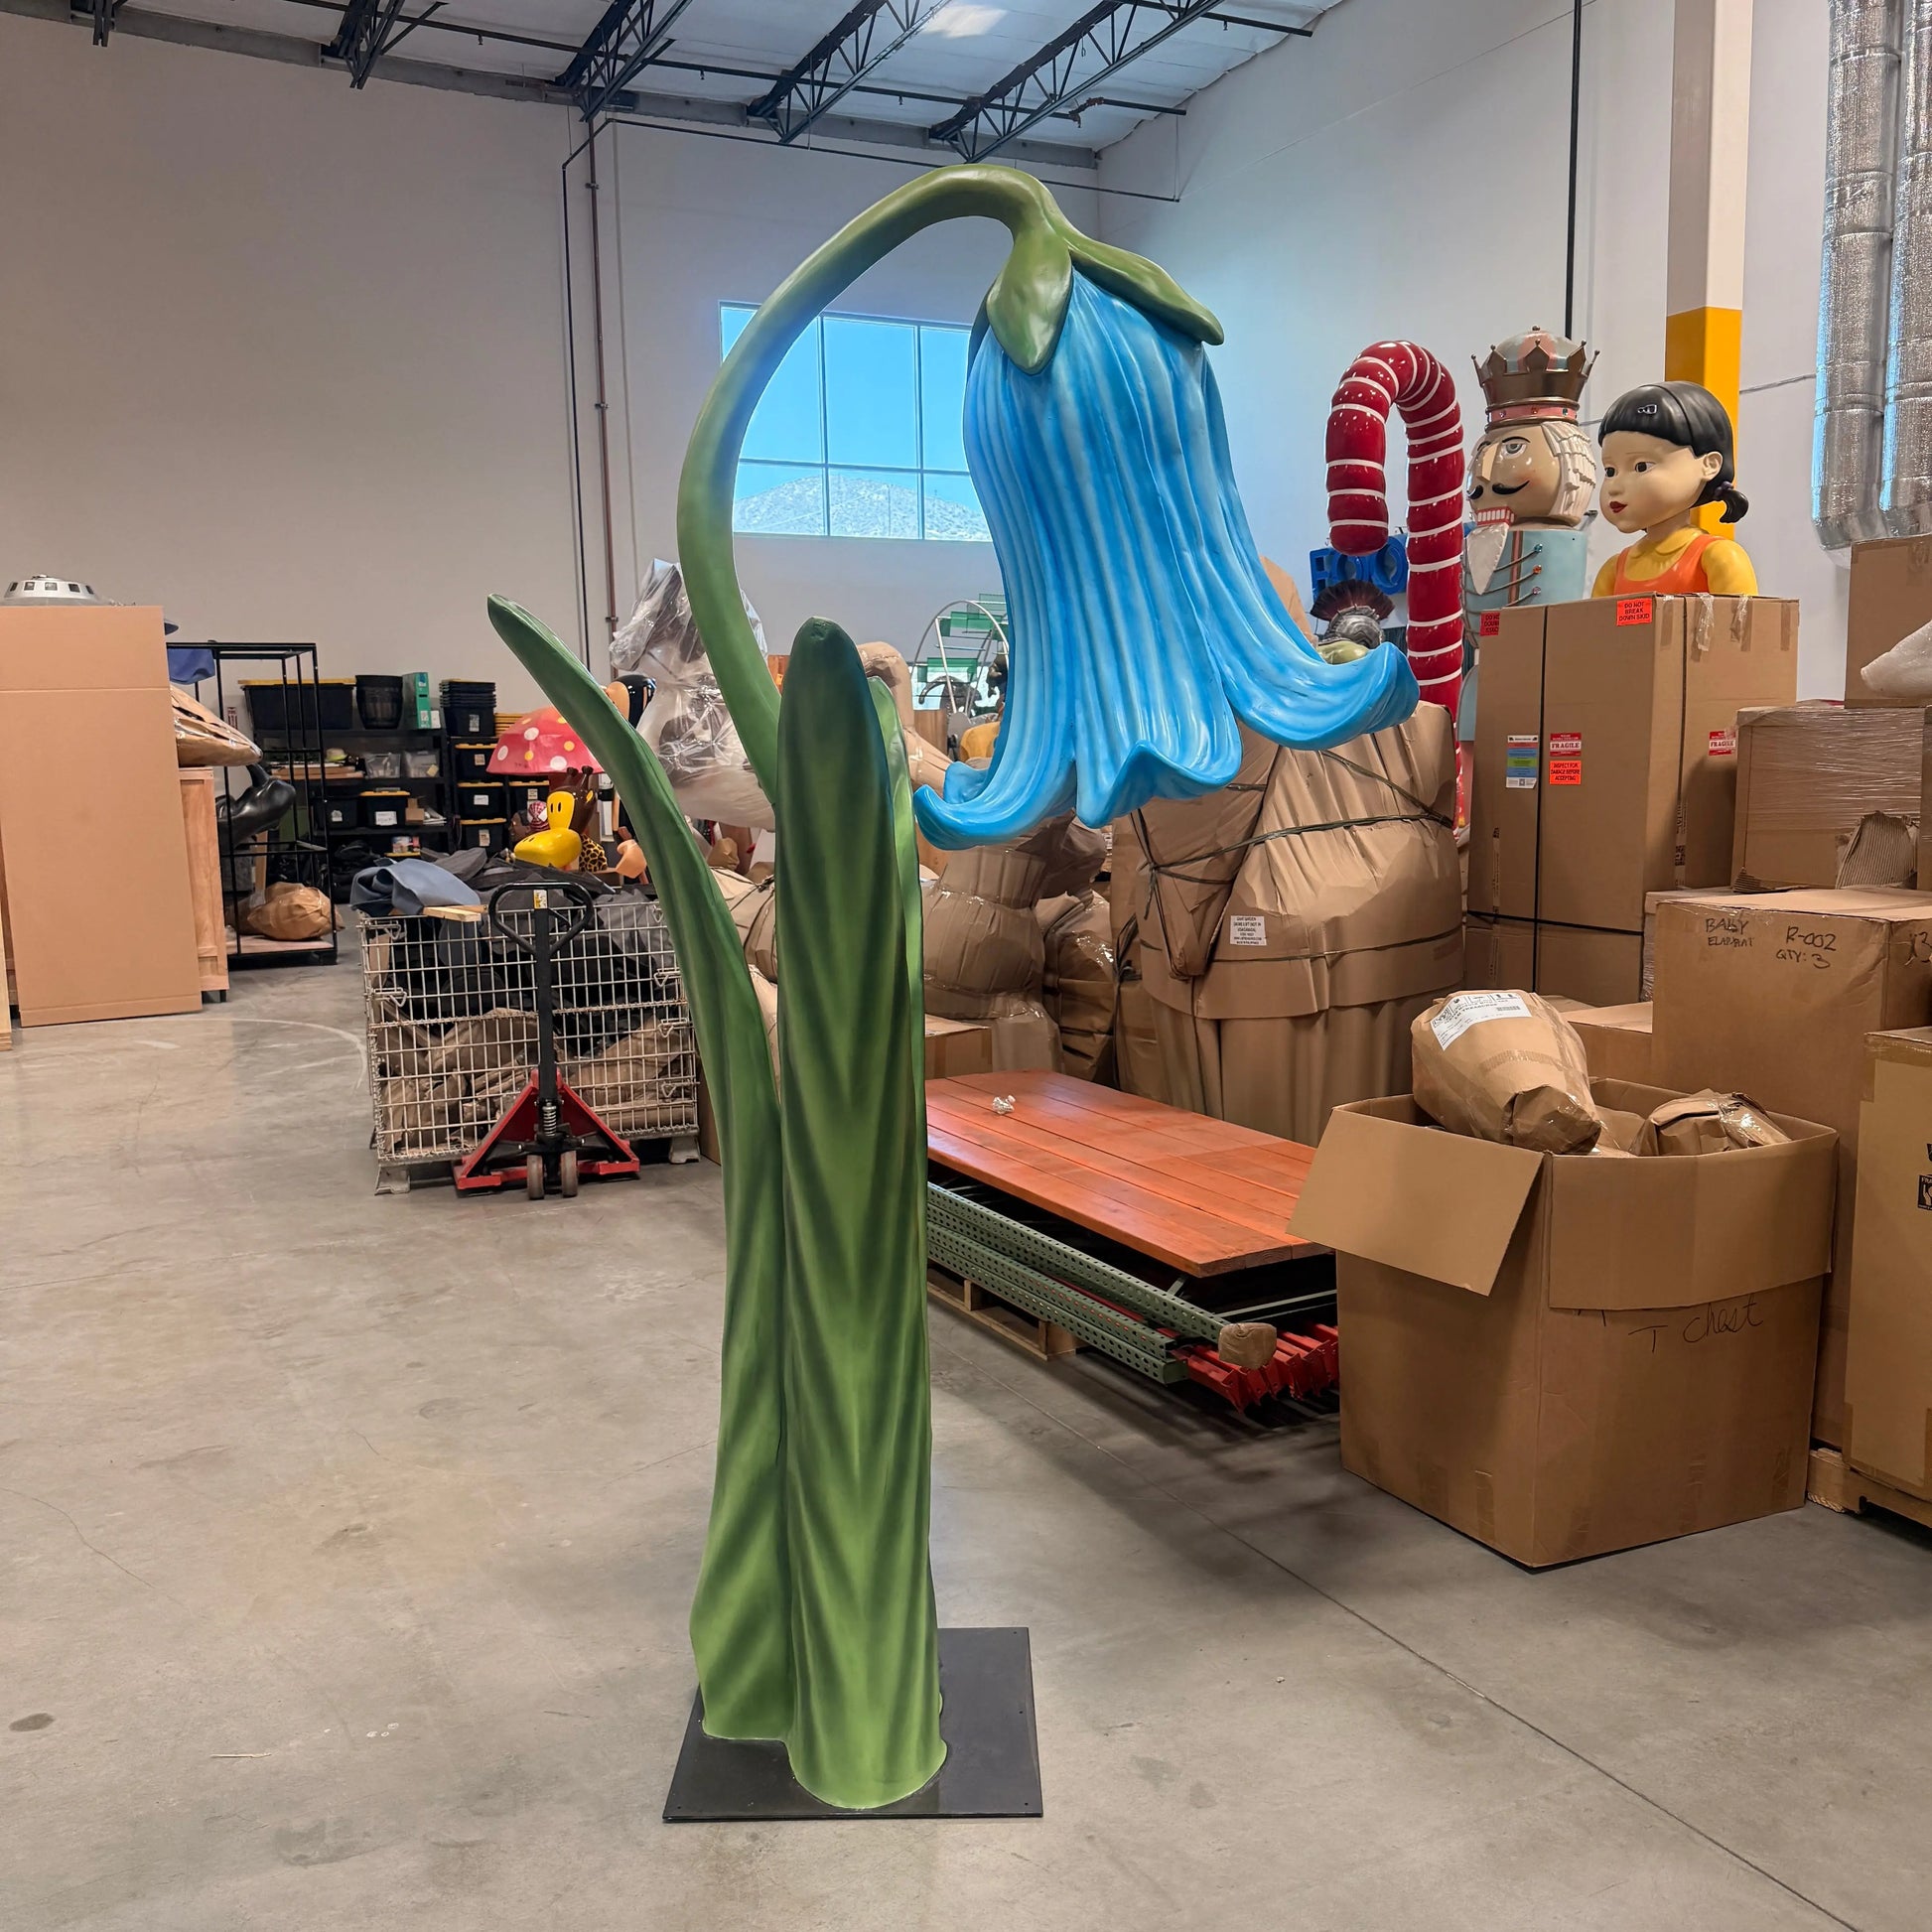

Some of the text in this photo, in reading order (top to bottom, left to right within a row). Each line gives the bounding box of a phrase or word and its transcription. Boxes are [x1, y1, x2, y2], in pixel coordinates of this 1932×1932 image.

[1705, 917, 1749, 935] BABY
[1786, 925, 1837, 951] R-002
[1811, 953, 1832, 969] 3
